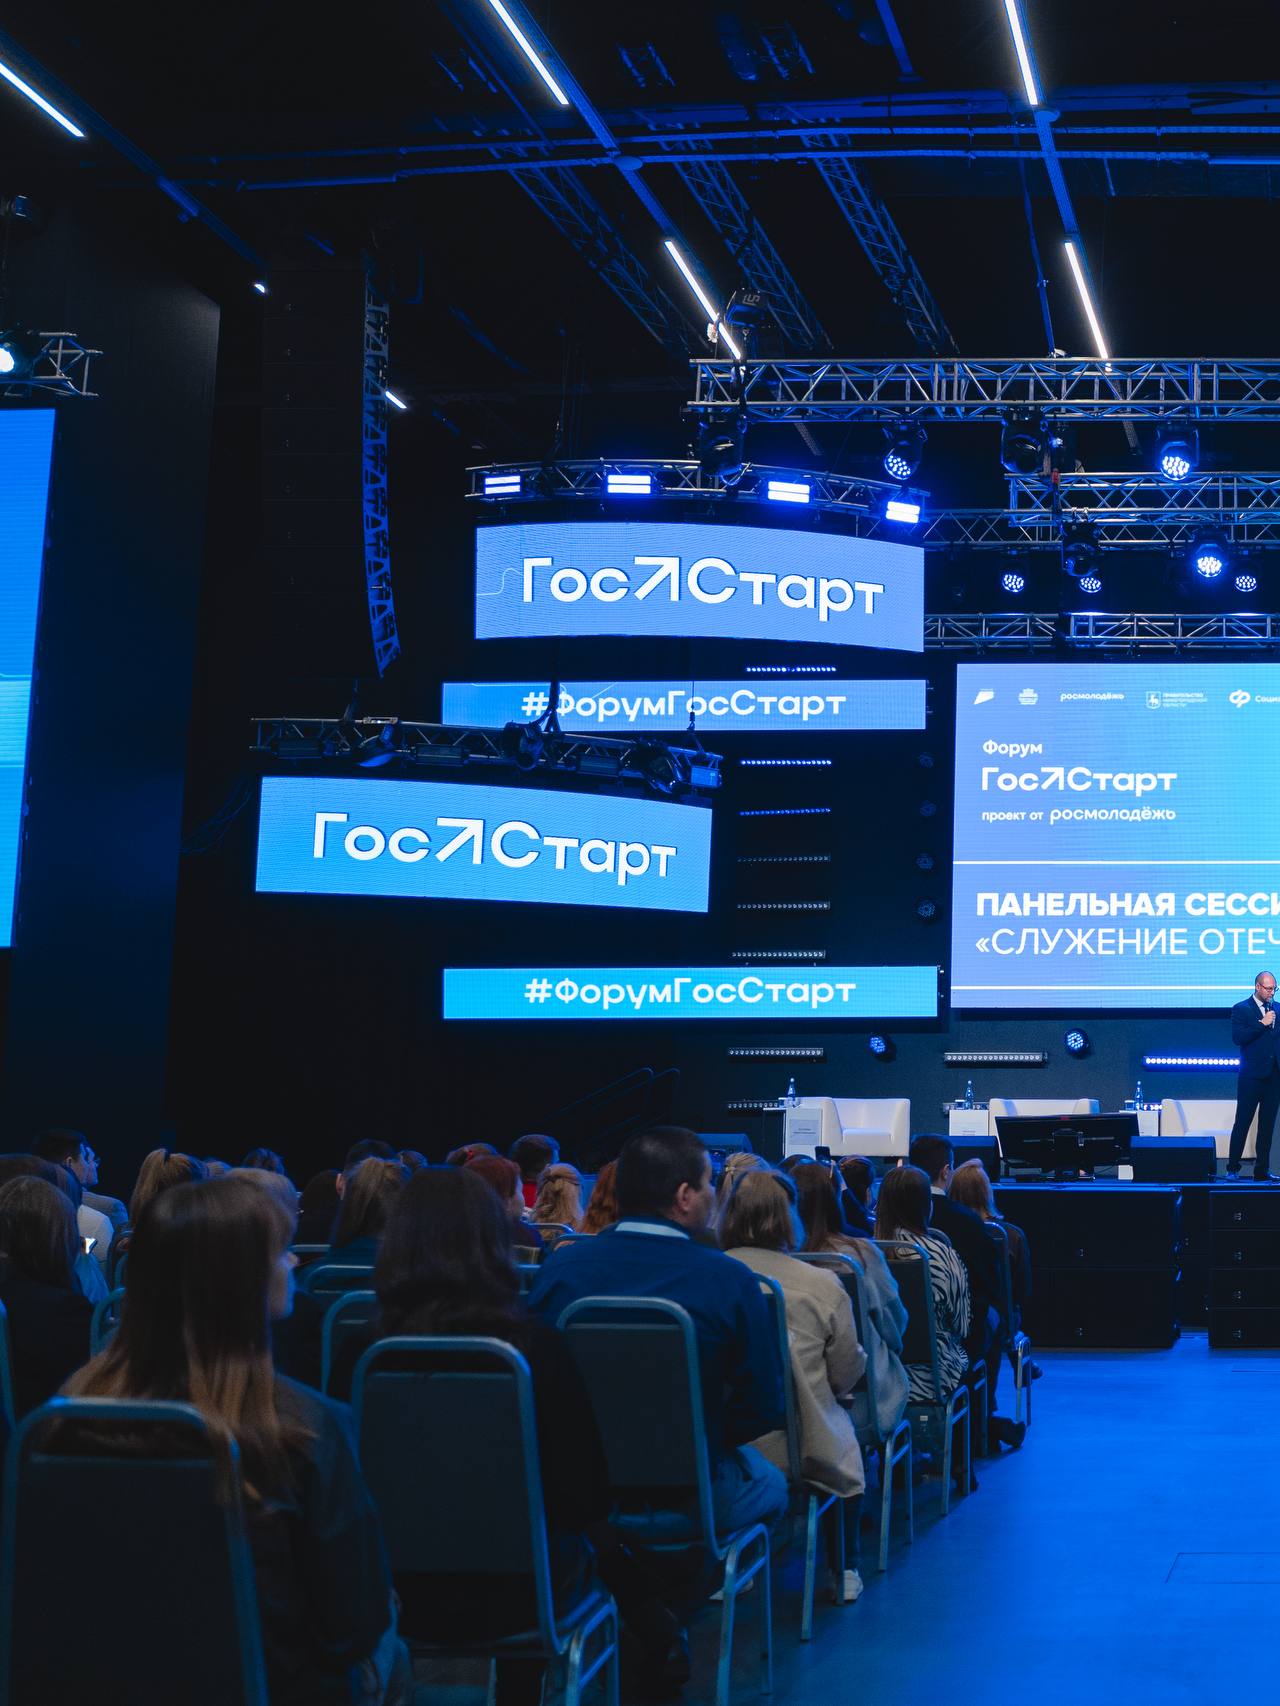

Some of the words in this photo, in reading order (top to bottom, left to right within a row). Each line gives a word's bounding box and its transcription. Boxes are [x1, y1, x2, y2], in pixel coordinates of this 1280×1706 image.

[521, 689, 847, 722] #ФорумГосСтарт
[982, 739, 1043, 758] Форум
[981, 811, 1026, 823] проект
[1029, 811, 1044, 821] от
[1049, 806, 1177, 825] росмолодёжь
[976, 892, 1176, 916] ПАНЕЛЬНАЯ
[975, 927, 1188, 955] «СЛУЖЕНИЕ
[524, 976, 857, 1010] #ФорумГосСтарт
